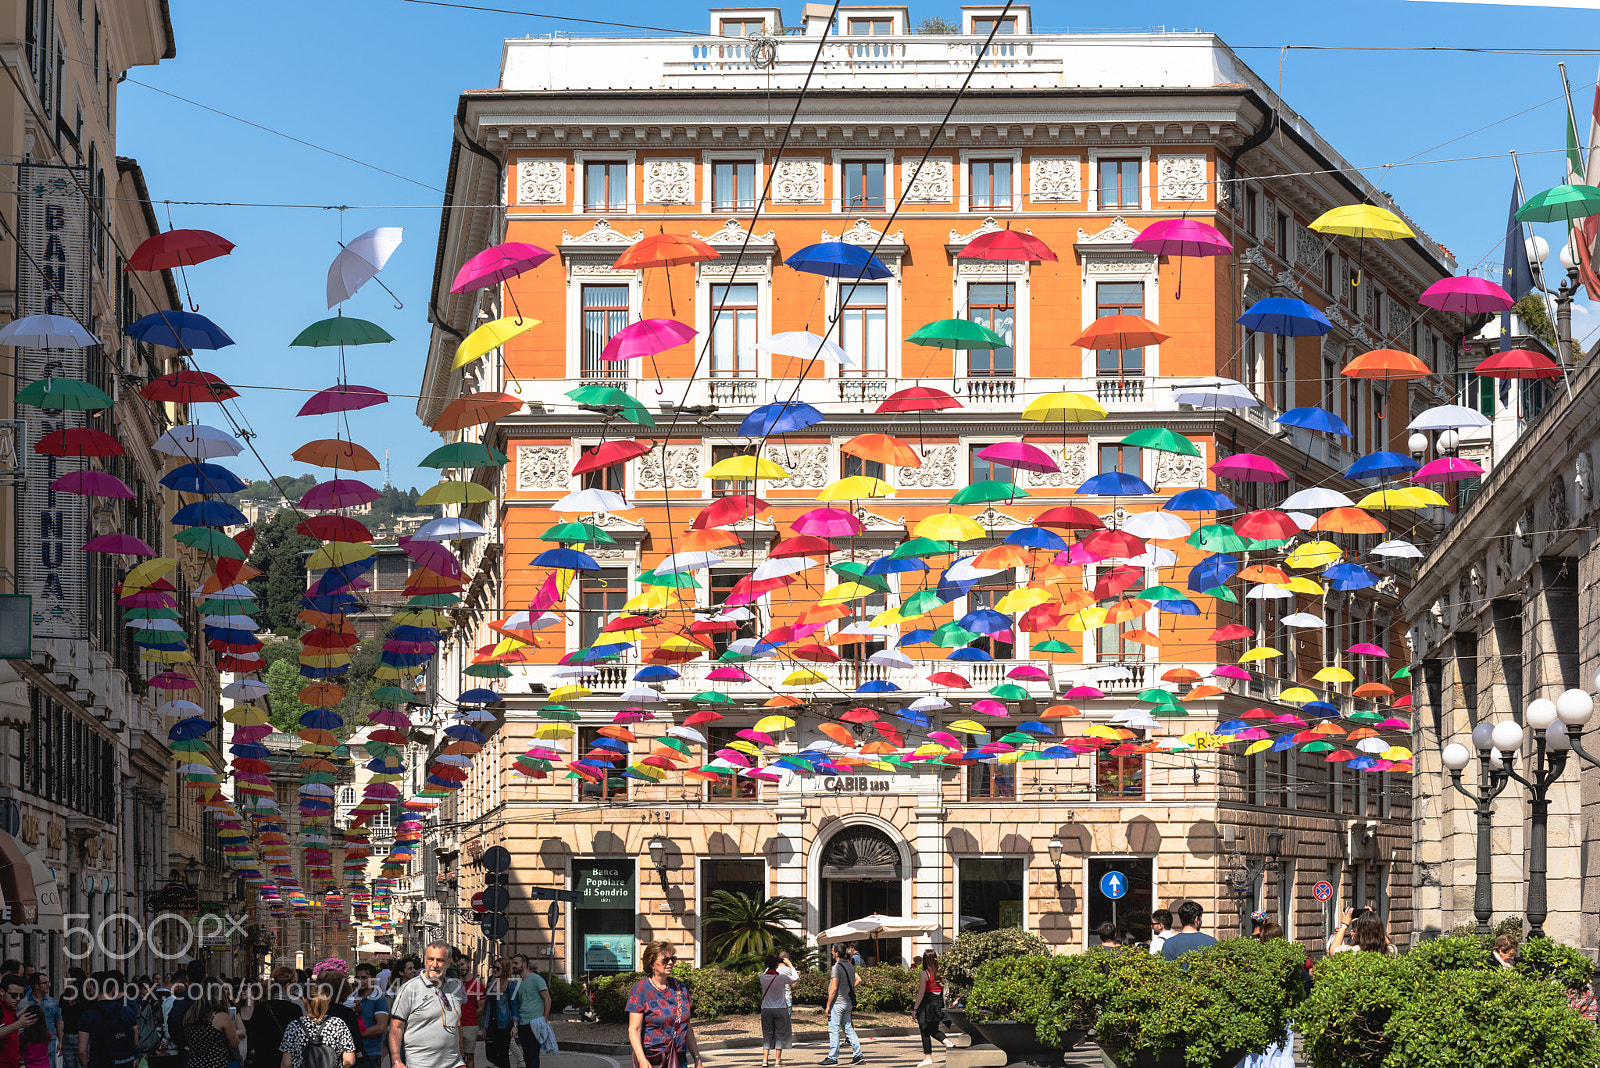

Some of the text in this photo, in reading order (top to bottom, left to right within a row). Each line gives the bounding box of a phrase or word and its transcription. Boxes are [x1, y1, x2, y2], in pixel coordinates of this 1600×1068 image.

[1197, 737, 1207, 749] R
[824, 777, 868, 792] CABIB
[592, 867, 619, 876] Banca
[586, 878, 625, 887] Popolare
[584, 888, 629, 896] di Sondrio
